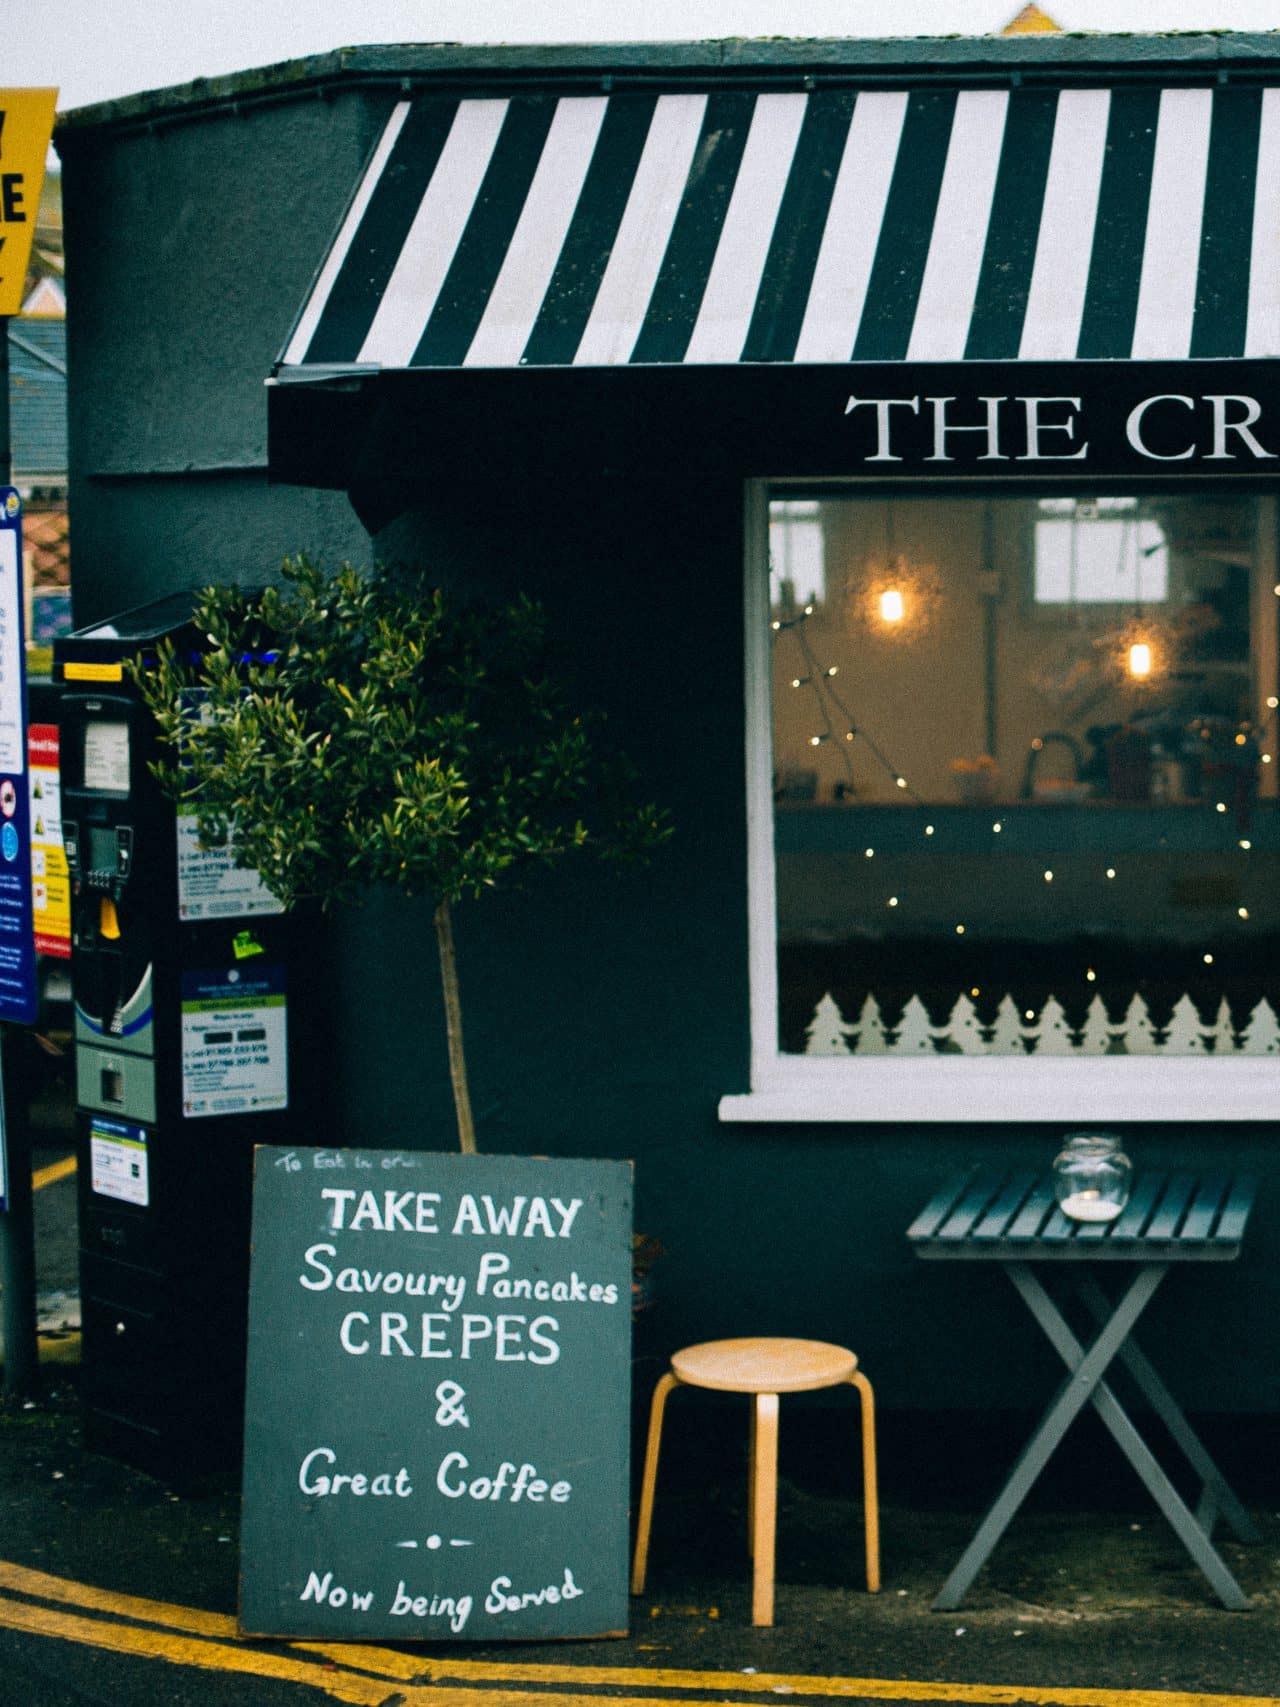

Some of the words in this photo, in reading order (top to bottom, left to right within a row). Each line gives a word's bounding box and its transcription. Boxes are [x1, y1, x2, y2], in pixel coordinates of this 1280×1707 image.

[844, 394, 1090, 463] THE
[275, 1153, 302, 1173] To
[313, 1153, 345, 1170] Eat
[321, 1188, 442, 1234] TAKE
[452, 1195, 584, 1239] AWAY
[299, 1243, 467, 1313] Savoury
[476, 1252, 620, 1305] Pancakes
[339, 1311, 561, 1366] CREPES
[435, 1379, 471, 1428] &
[299, 1447, 413, 1498] Great
[436, 1451, 573, 1503] Coffee
[299, 1570, 375, 1612] Now
[389, 1580, 474, 1633] being
[485, 1567, 585, 1615] Served
